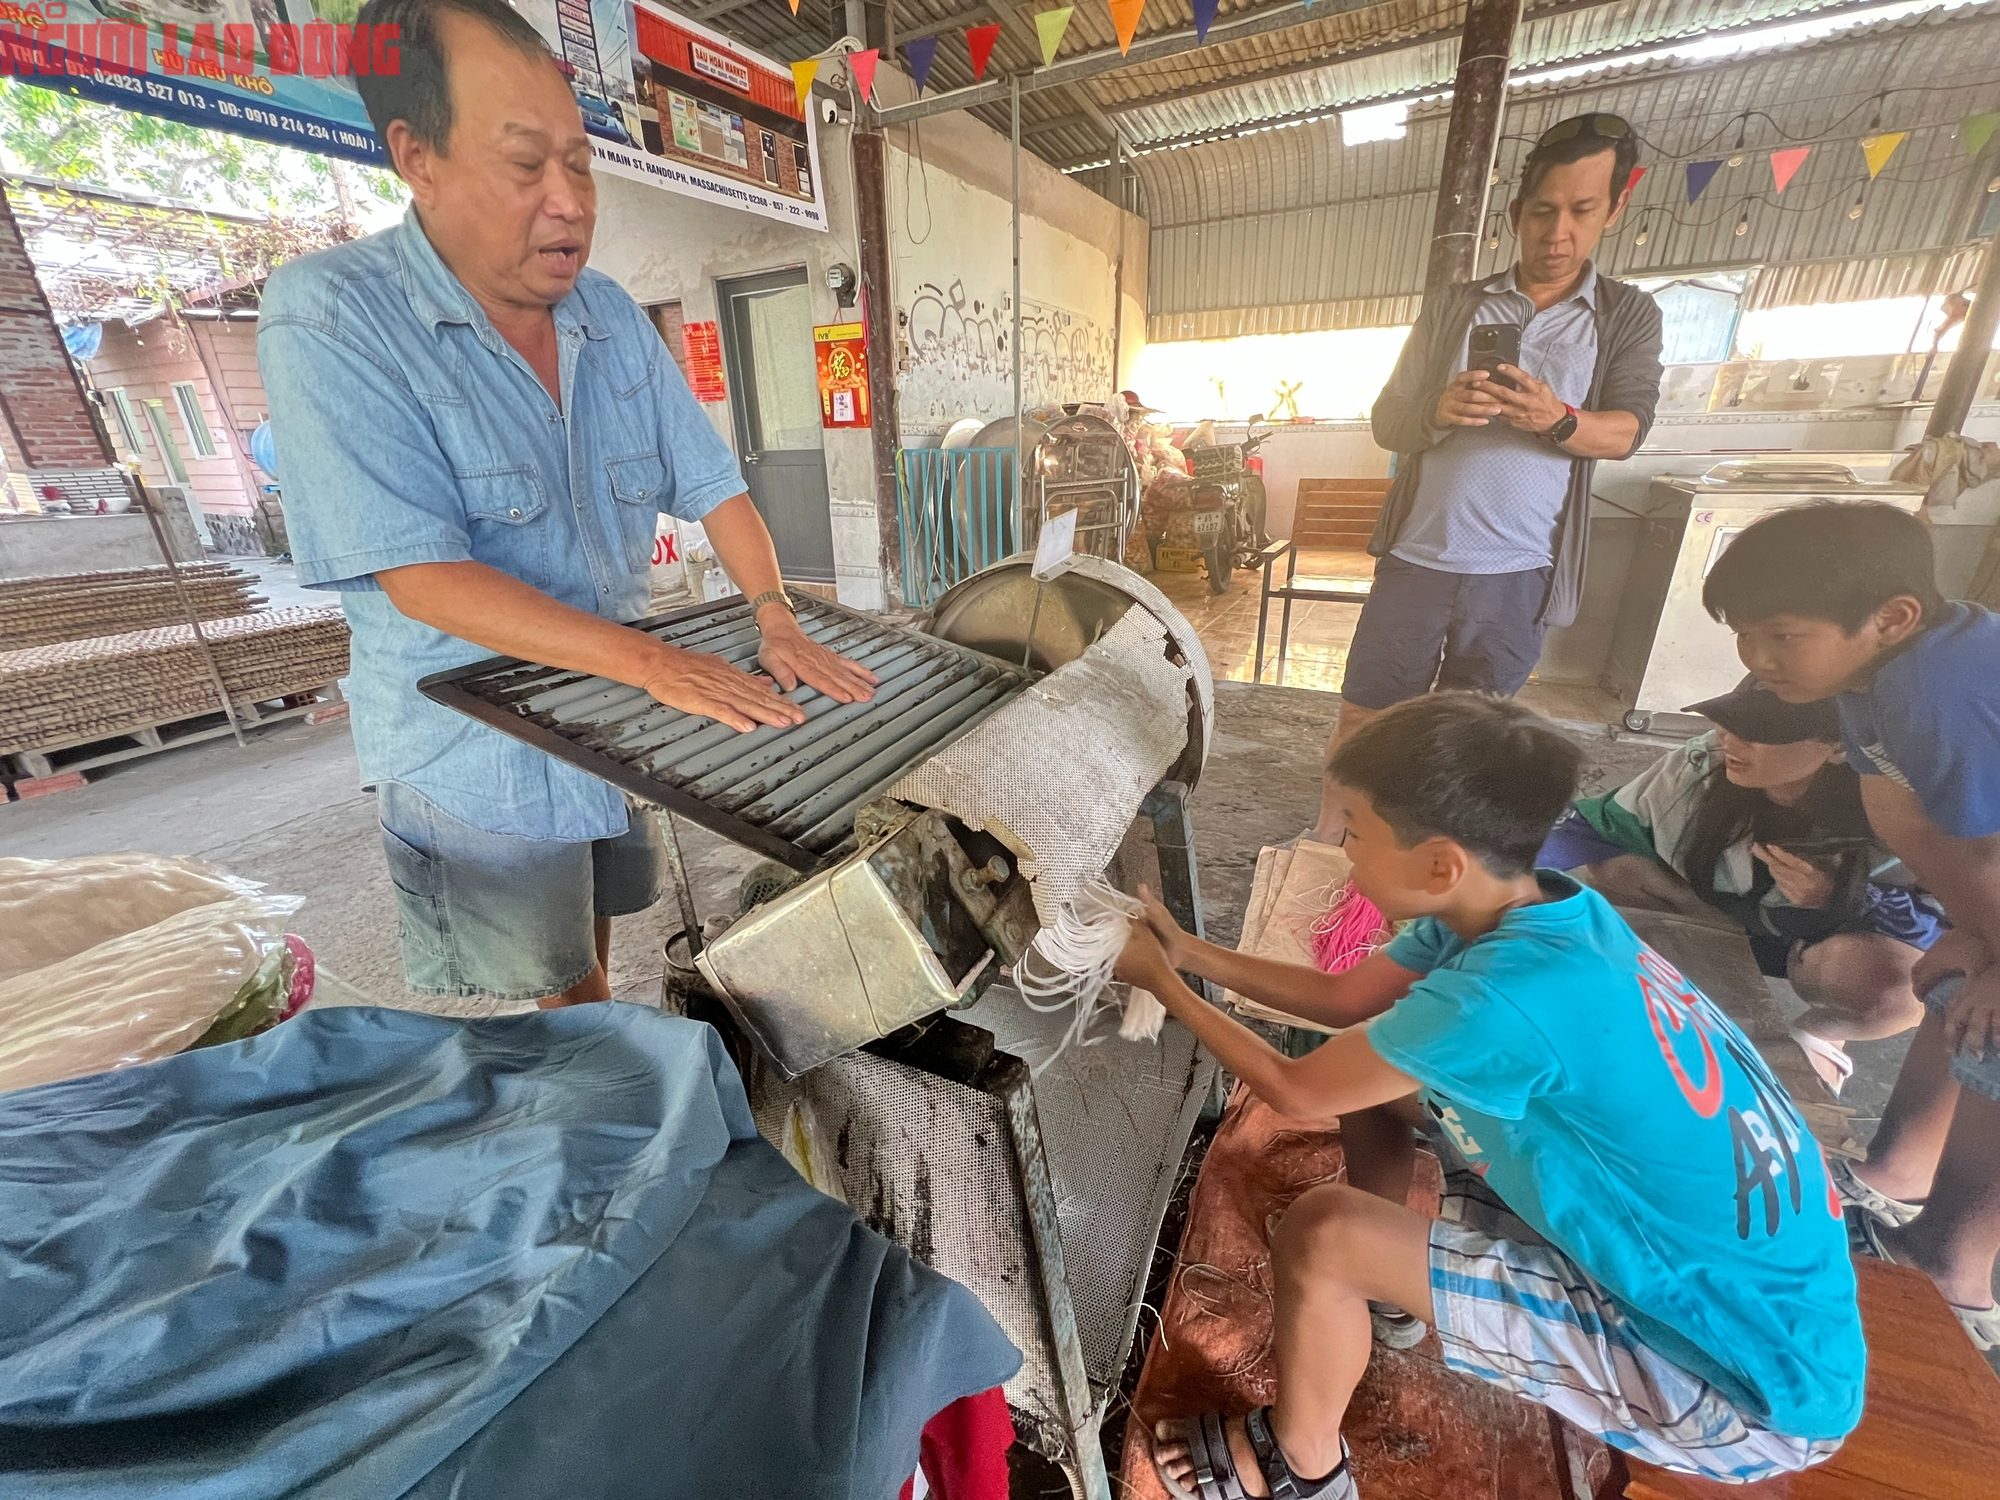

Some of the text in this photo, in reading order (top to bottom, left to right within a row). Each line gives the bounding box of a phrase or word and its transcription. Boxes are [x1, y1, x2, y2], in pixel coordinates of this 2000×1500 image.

[232, 73, 275, 96] KHÔ
[724, 61, 747, 80] MARKET
[93, 67, 143, 91] 02923
[145, 81, 173, 101] 527
[177, 89, 206, 110] 013
[244, 107, 277, 128] 0918
[280, 115, 305, 135] 214
[306, 122, 329, 140] 234
[598, 147, 606, 160] N
[607, 150, 631, 167] MAIN
[689, 175, 748, 202] MASSACHUSETTS
